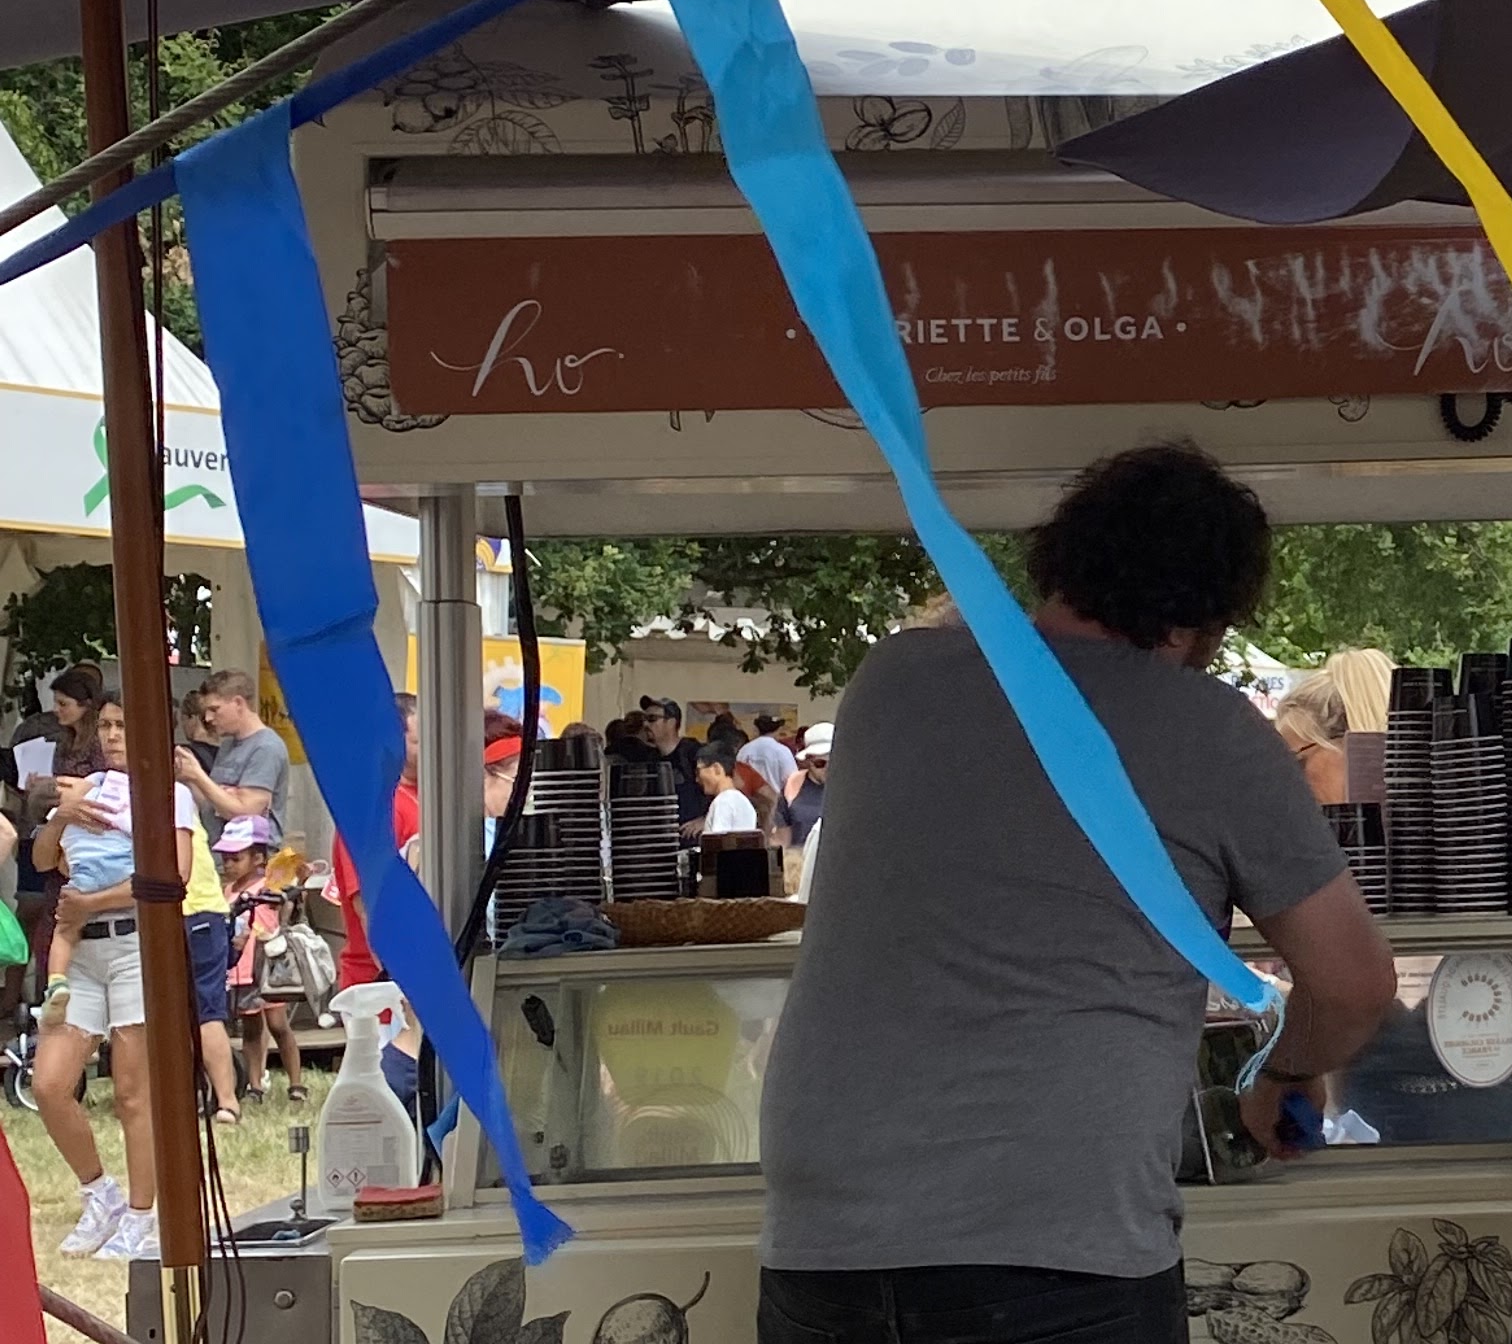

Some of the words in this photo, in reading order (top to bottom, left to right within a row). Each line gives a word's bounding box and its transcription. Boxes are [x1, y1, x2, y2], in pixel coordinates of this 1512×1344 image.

[895, 318, 1021, 344] RIETTE
[1033, 316, 1053, 342] &
[1064, 315, 1165, 341] OLGA
[964, 366, 986, 383] les
[988, 367, 1032, 386] petits
[163, 447, 227, 472] auver
